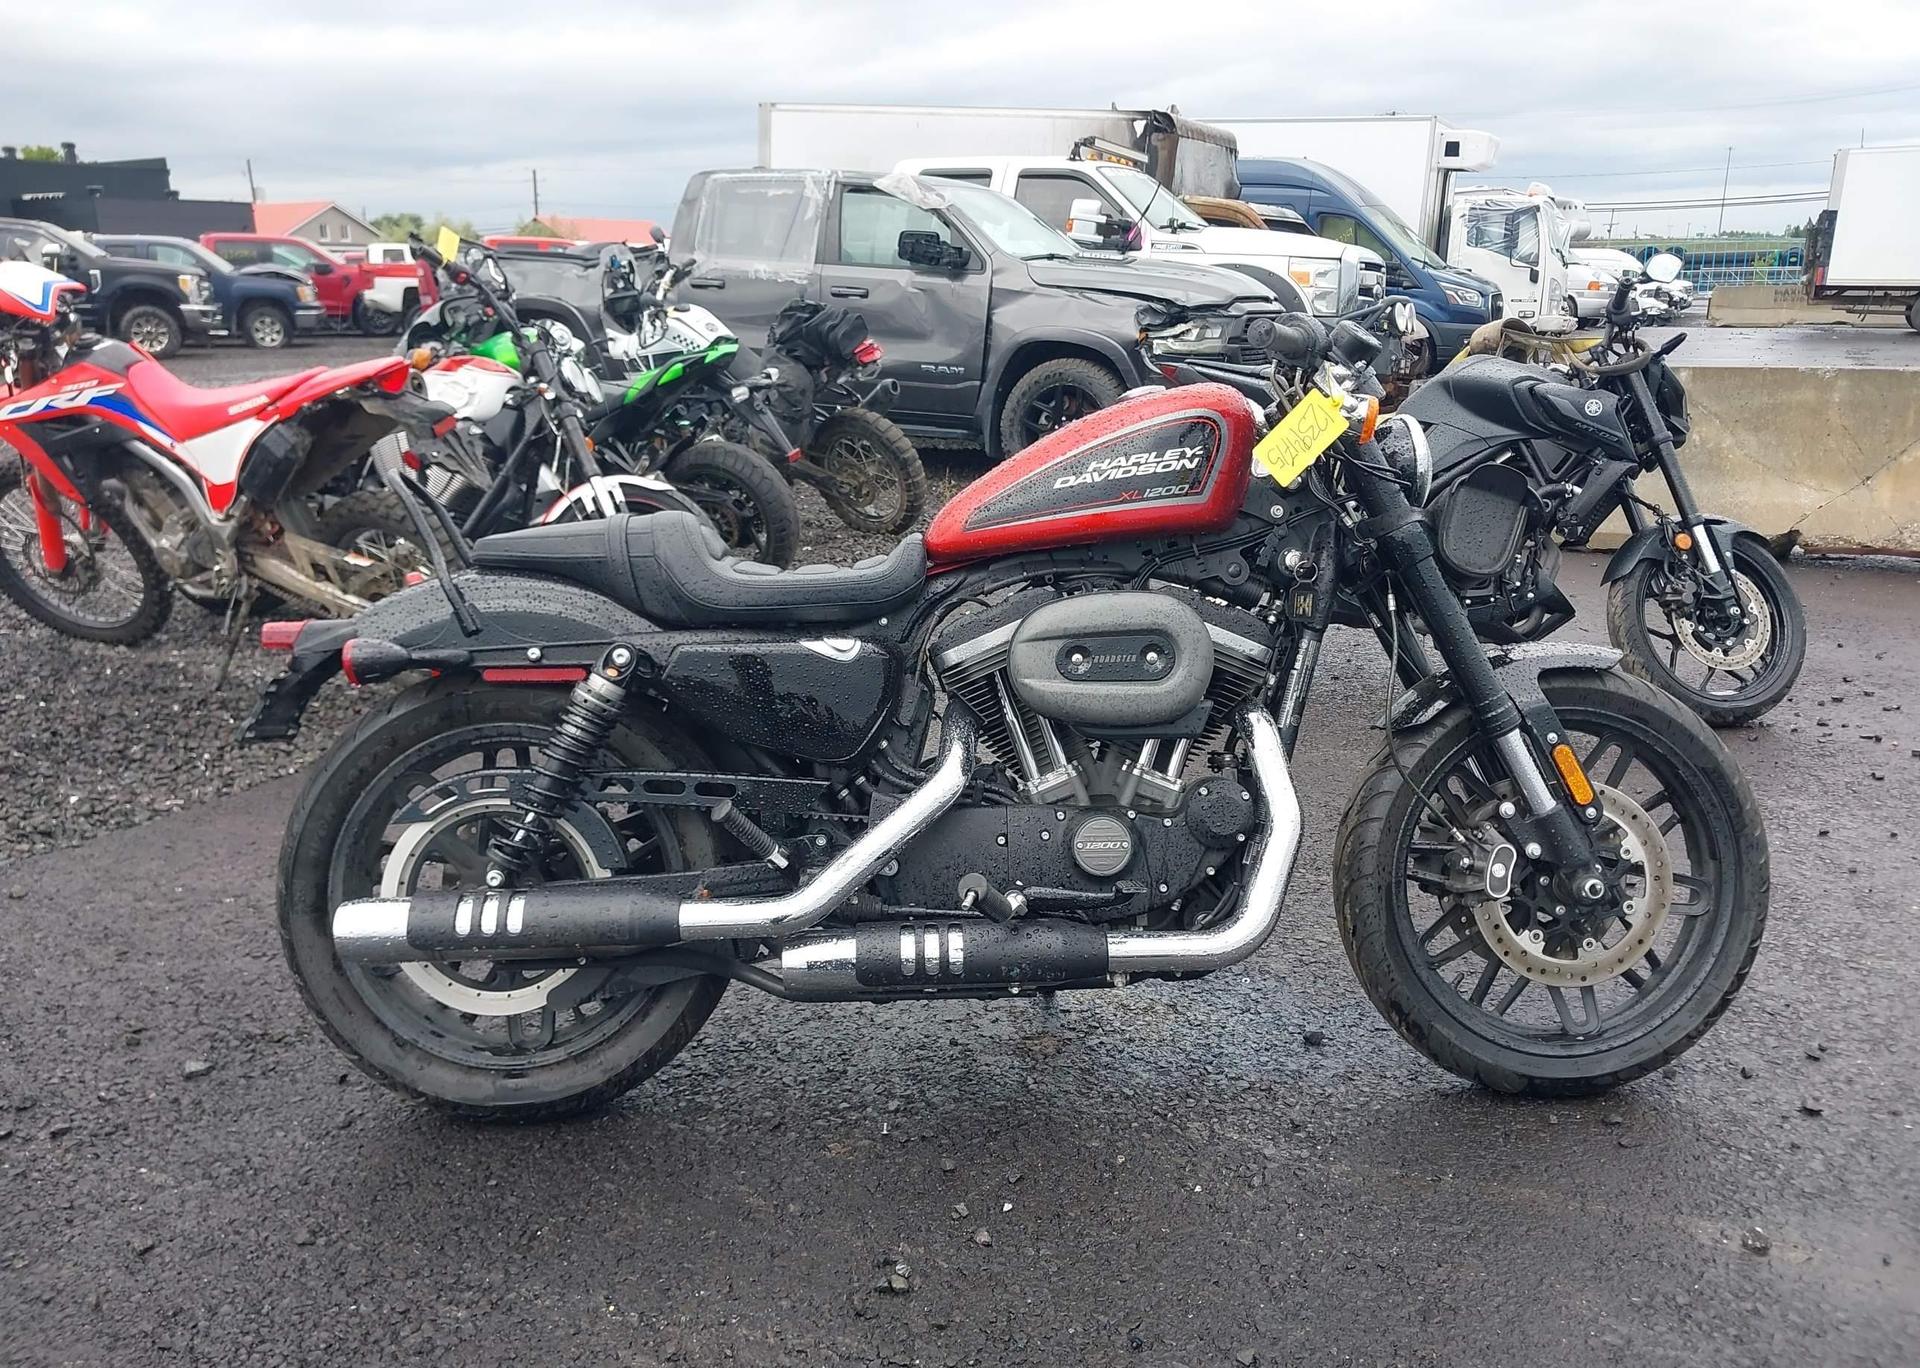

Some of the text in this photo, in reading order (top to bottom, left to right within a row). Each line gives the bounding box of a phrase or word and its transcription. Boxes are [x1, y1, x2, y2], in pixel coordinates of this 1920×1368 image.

[920, 364, 965, 376] RAM
[0, 382, 126, 420] CRF
[1575, 421, 1619, 442] MT-03
[1087, 445, 1204, 473] HARLEY-
[1052, 457, 1202, 490] DAVIDSON
[1092, 654, 1137, 663] ROADSTER
[1085, 841, 1121, 849] 1200
